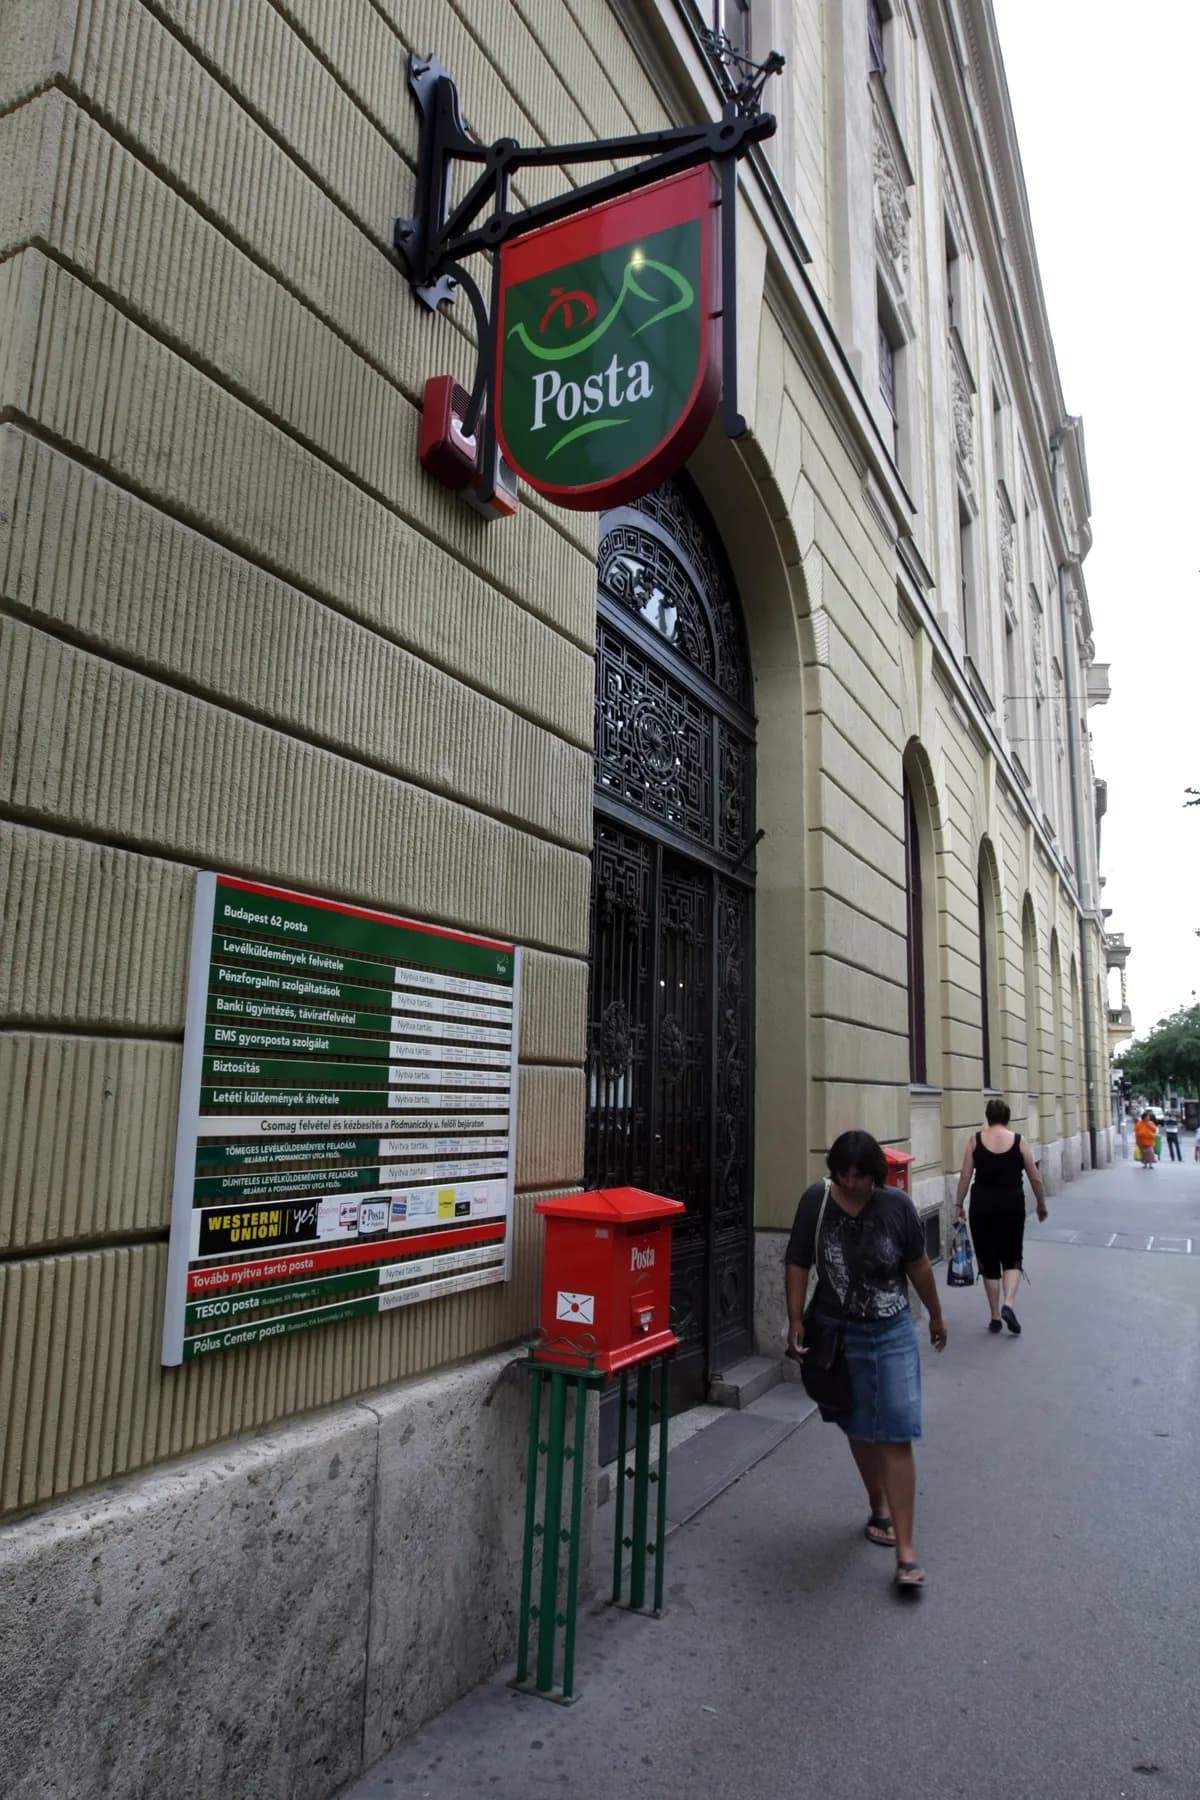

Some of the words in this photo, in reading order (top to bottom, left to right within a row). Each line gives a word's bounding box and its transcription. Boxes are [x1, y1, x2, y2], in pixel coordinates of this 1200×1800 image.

[530, 353, 654, 431] Posta
[223, 905, 269, 924] Budapest
[270, 915, 282, 928] 62
[283, 919, 308, 933] posta
[223, 940, 307, 965] Levélküldemények
[308, 954, 344, 971] felvétele
[218, 968, 280, 989] Pénzforgalmi
[281, 980, 341, 997] szolgáltatások
[216, 998, 244, 1012] Banki
[245, 1001, 297, 1019] ügyintézés,
[299, 1008, 356, 1025] táviratfelvétel
[214, 1029, 237, 1042] EMS
[238, 1033, 291, 1048] gyorsposta
[292, 1036, 329, 1051] szolgálat
[212, 1060, 260, 1074] Biztosítás
[213, 1090, 242, 1103] Letéti
[244, 1091, 305, 1107] küldemények
[306, 1093, 340, 1105] átvétele
[260, 1120, 297, 1133] Csomag
[299, 1120, 331, 1130] felvétel
[332, 1120, 342, 1131] és
[343, 1119, 383, 1131] kézbesítés
[390, 1119, 432, 1131] Podmaniczky
[457, 1119, 485, 1130] bejáraton
[225, 1144, 260, 1156] TÖMEGES
[260, 1141, 326, 1154] LEVÉLKÜLDEMÉNYEK
[326, 1141, 357, 1151] FELADÁSA
[261, 1172, 327, 1185] LEVÉLKÜLDEMÉNYEK
[327, 1170, 359, 1180] FELADÁSA
[208, 1210, 280, 1231] WESTERN
[367, 1207, 385, 1222] Posta
[230, 1223, 279, 1243] UNION
[629, 1245, 655, 1272] Posta
[192, 1271, 229, 1287] Tovább
[231, 1267, 262, 1284] nyitva
[263, 1260, 288, 1275] tartó
[288, 1257, 315, 1274] posta
[195, 1301, 230, 1319] TESCO
[231, 1297, 260, 1315] posta
[193, 1338, 221, 1354] Pólus
[223, 1330, 257, 1347] Center
[258, 1323, 286, 1341] posta
